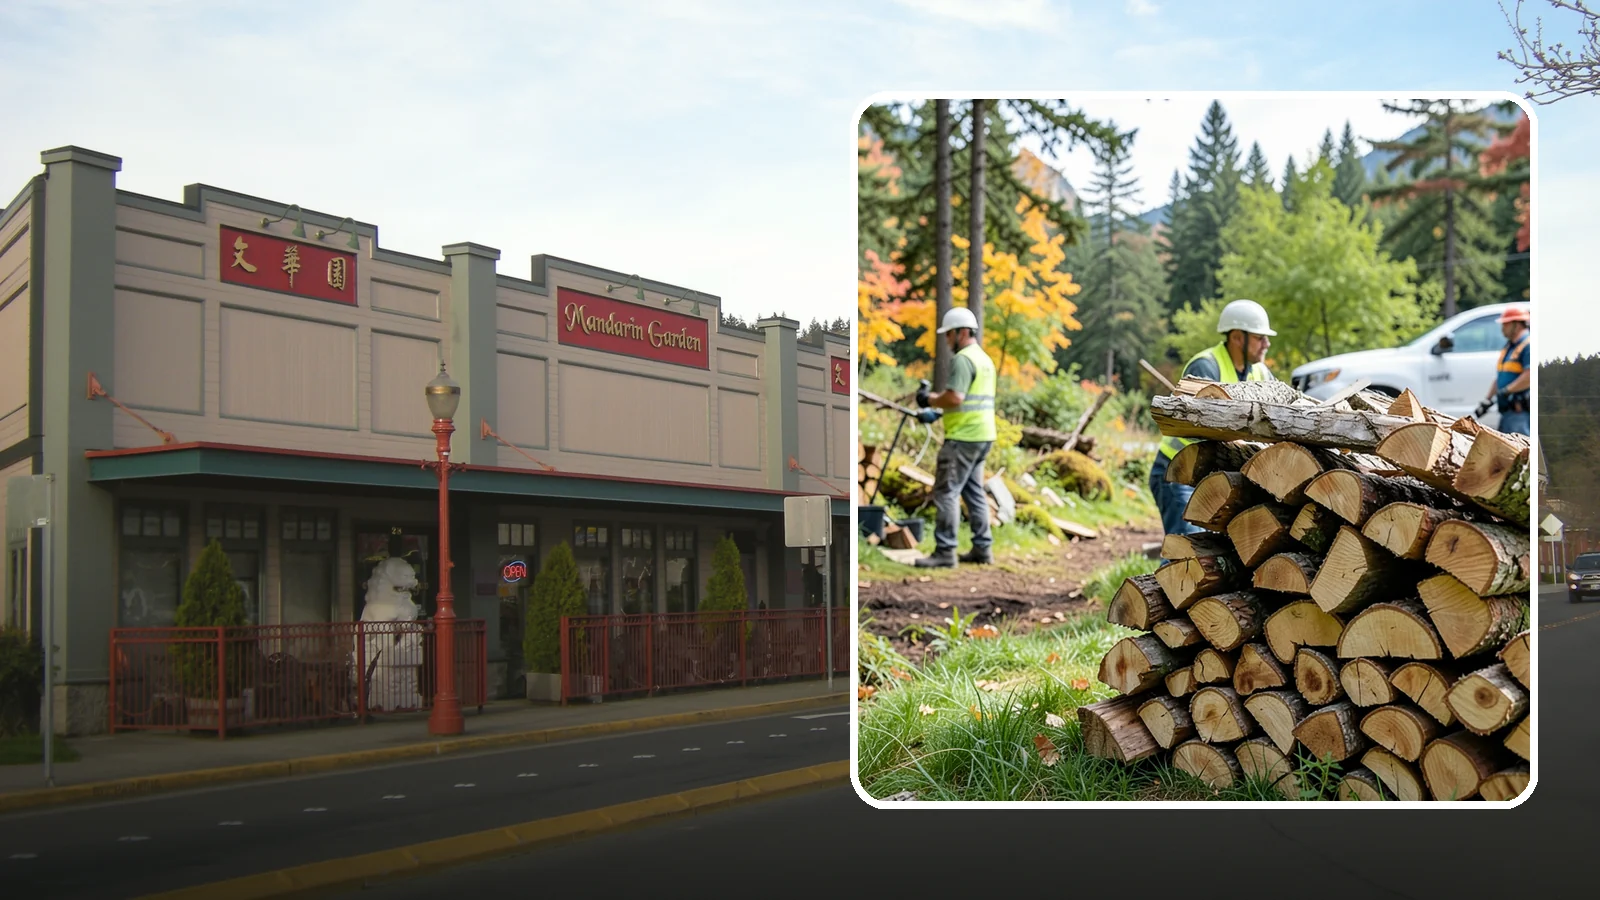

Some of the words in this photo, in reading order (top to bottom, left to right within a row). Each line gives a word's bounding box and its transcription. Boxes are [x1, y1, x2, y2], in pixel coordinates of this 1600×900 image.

[230, 235, 347, 291] 文華園
[564, 302, 645, 341] Mandarin
[647, 320, 702, 352] Garden
[503, 565, 527, 578] OPEN
